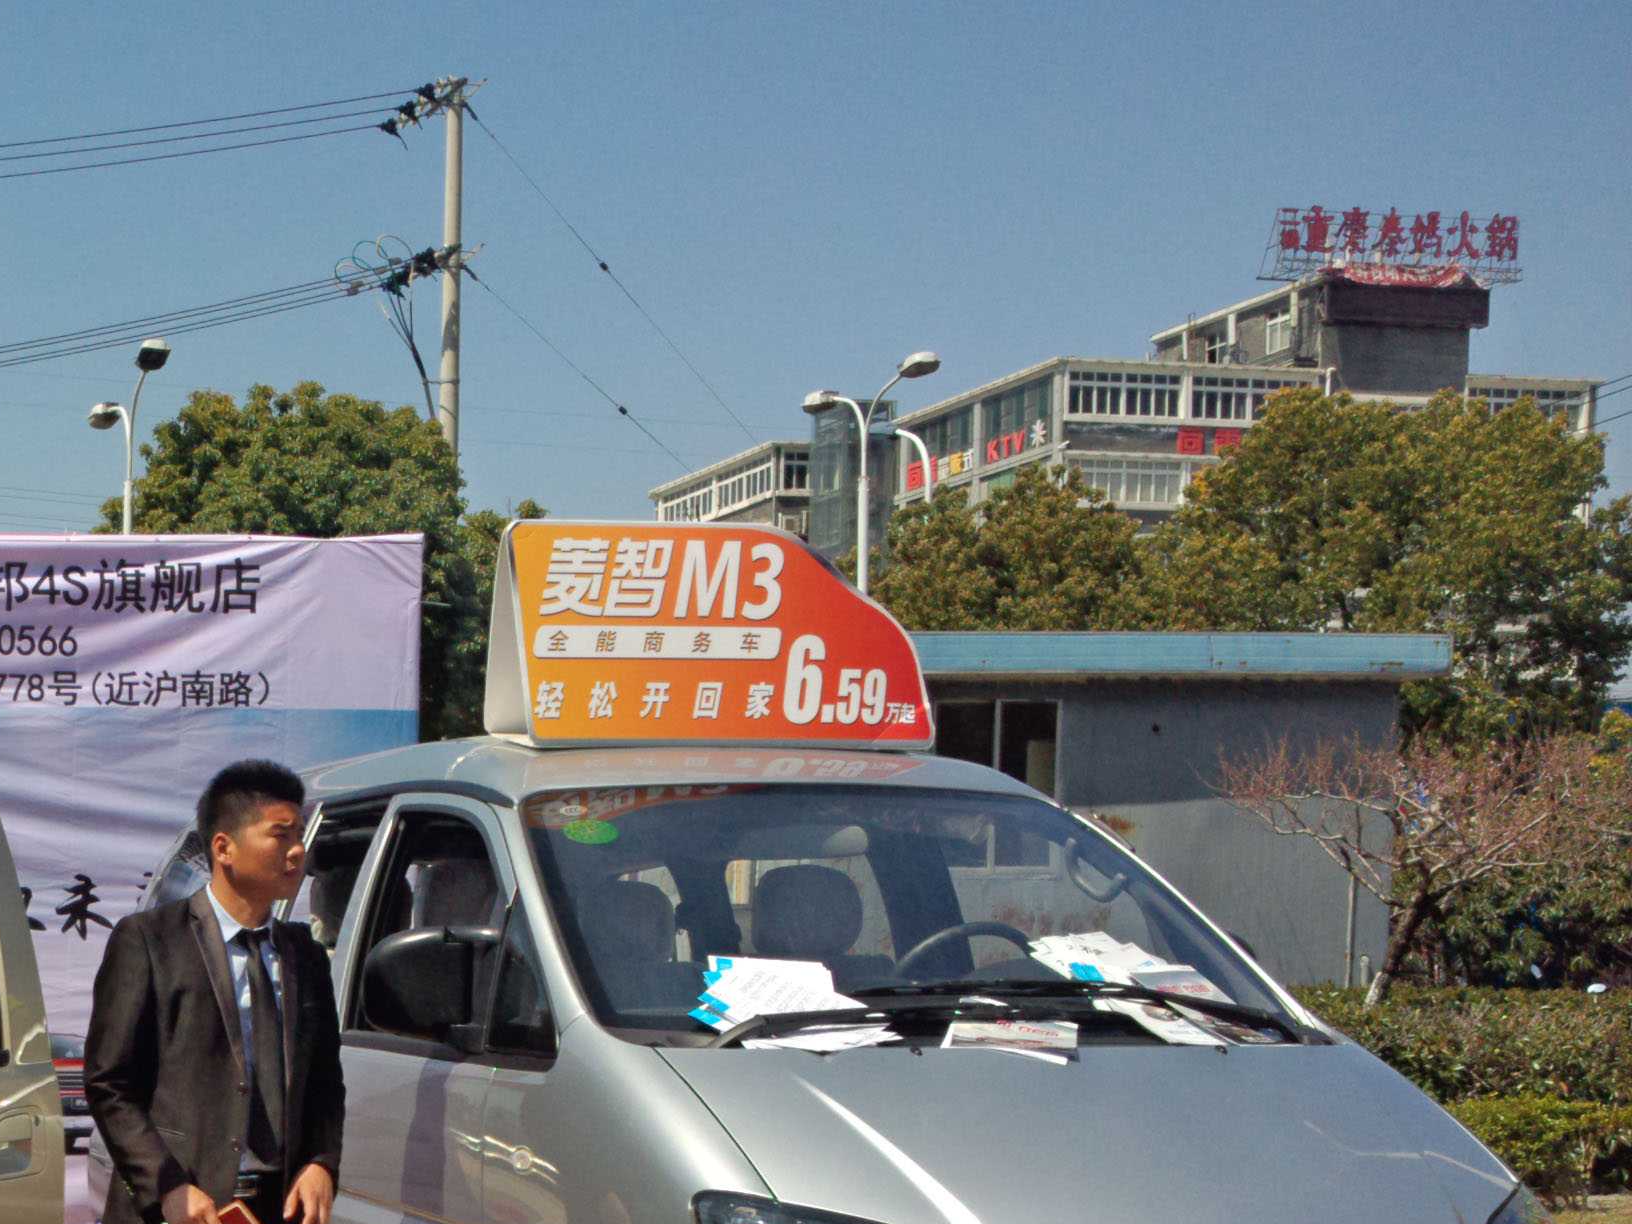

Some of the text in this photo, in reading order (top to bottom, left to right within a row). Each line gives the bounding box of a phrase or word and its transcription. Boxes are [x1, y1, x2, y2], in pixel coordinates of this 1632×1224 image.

[986, 428, 1026, 464] KTV
[538, 536, 786, 621] 菱智M3
[546, 629, 762, 655] 全能商务车
[782, 634, 916, 726] 6.59万起
[533, 681, 775, 721] 轻松开回家
